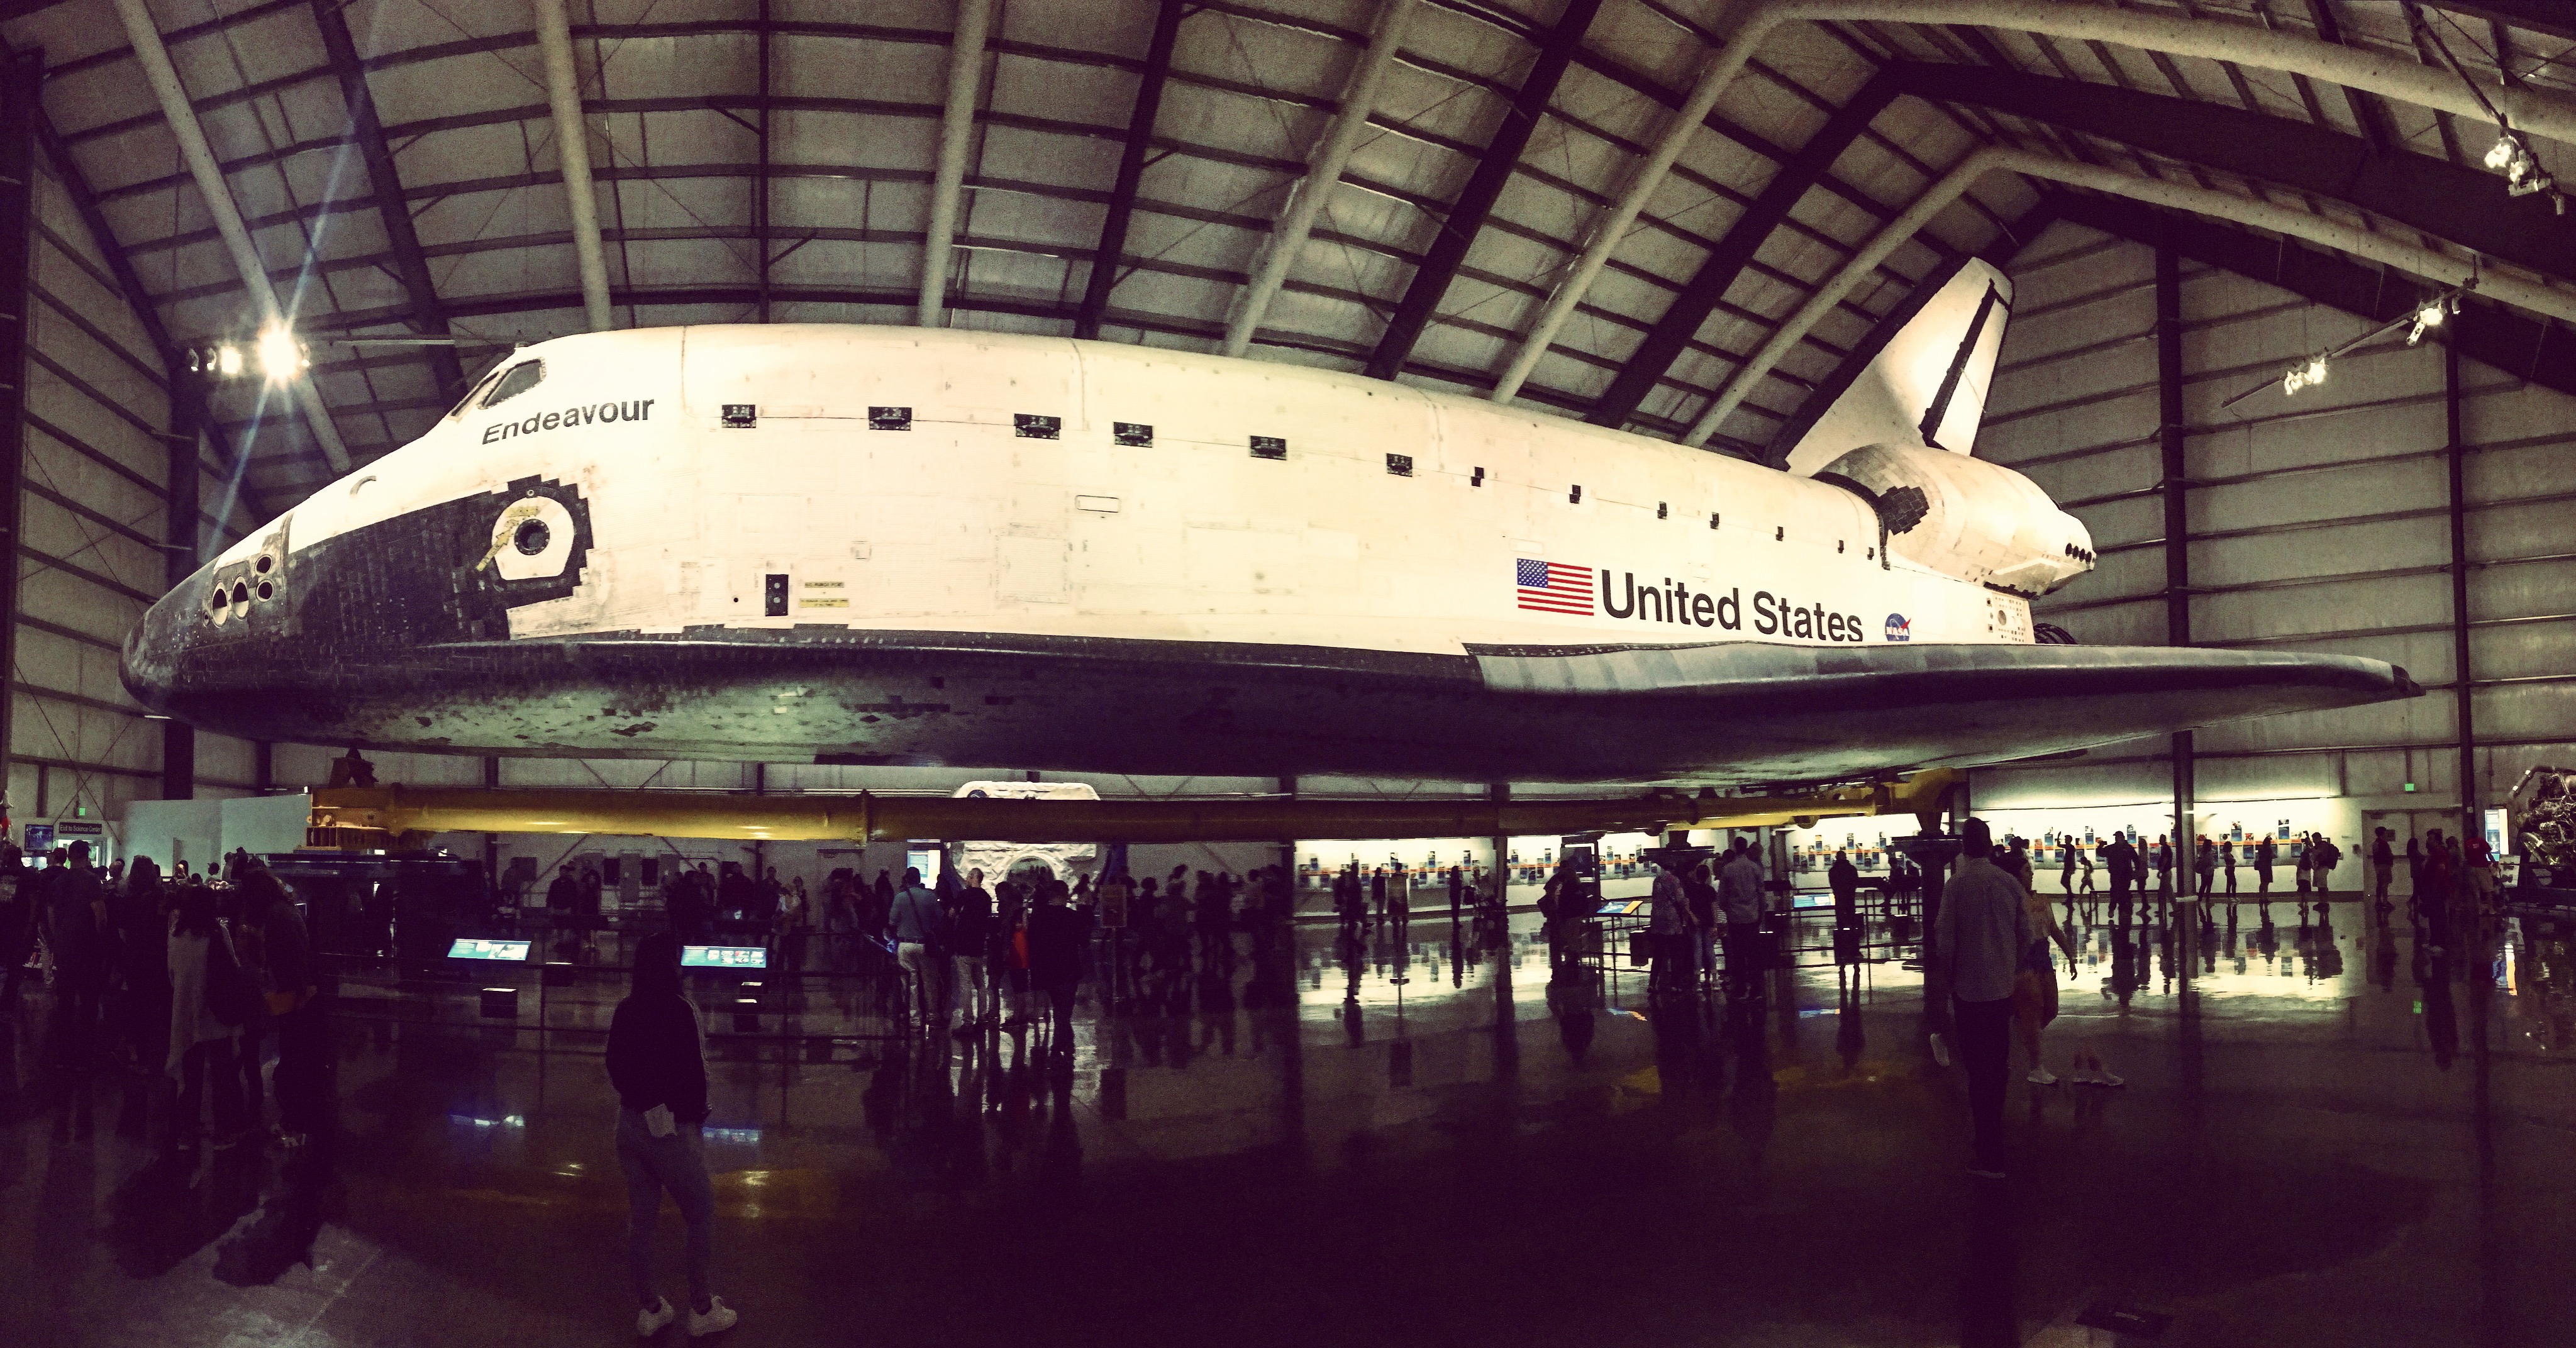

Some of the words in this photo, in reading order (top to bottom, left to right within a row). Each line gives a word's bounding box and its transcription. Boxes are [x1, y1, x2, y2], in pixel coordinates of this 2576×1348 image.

[482, 399, 655, 445] Endeavour
[1601, 569, 1741, 631] United
[1753, 590, 1863, 642] States
[1886, 627, 1909, 636] NASA
